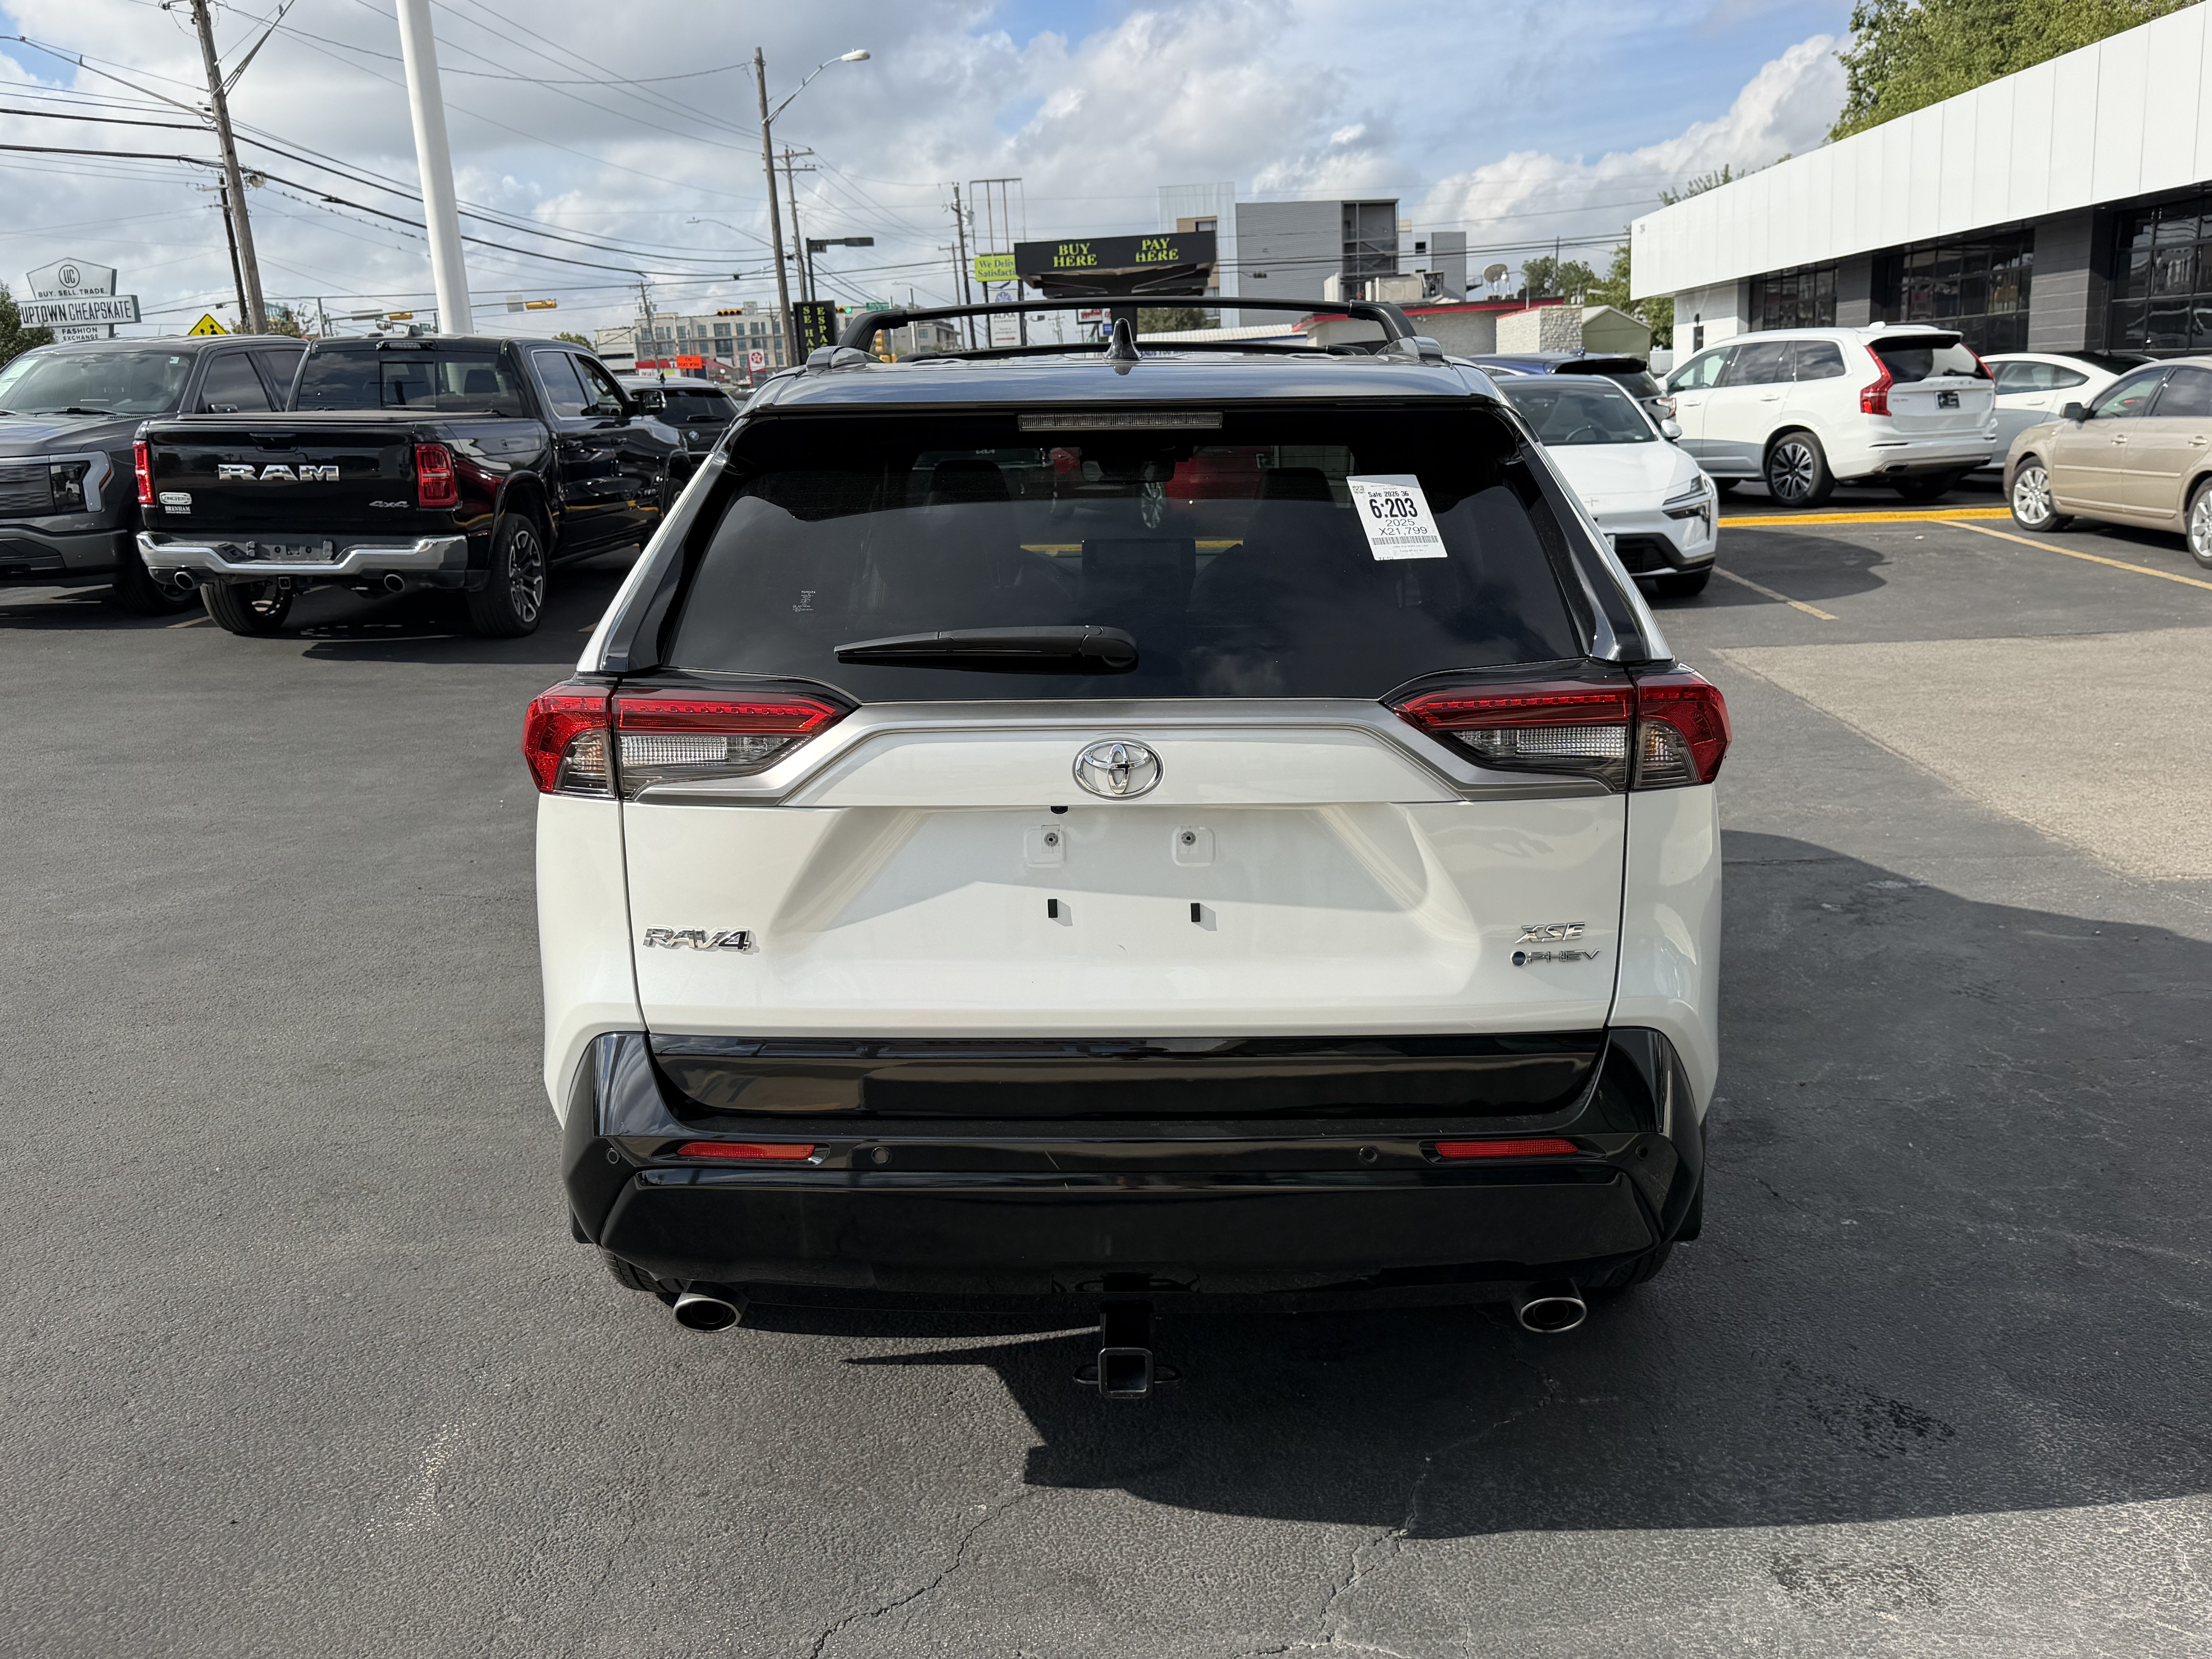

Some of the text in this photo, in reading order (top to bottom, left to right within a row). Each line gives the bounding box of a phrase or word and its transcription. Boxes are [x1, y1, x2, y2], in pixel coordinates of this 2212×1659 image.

[1059, 243, 1090, 256] BUY
[1142, 237, 1170, 251] PAY
[1053, 254, 1097, 267] HERE
[1135, 249, 1179, 262] HERE
[64, 269, 76, 283] UC
[21, 301, 132, 323] UPTOWN CHEAPSKATE
[803, 306, 812, 324] SE
[817, 306, 828, 347] ESPA
[218, 464, 340, 481] RAM
[1369, 498, 1418, 519] 6:203
[1379, 526, 1427, 536] X21,799
[643, 926, 752, 951] RAV4
[1515, 922, 1585, 943] XSE
[1527, 948, 1602, 963] PHEV
